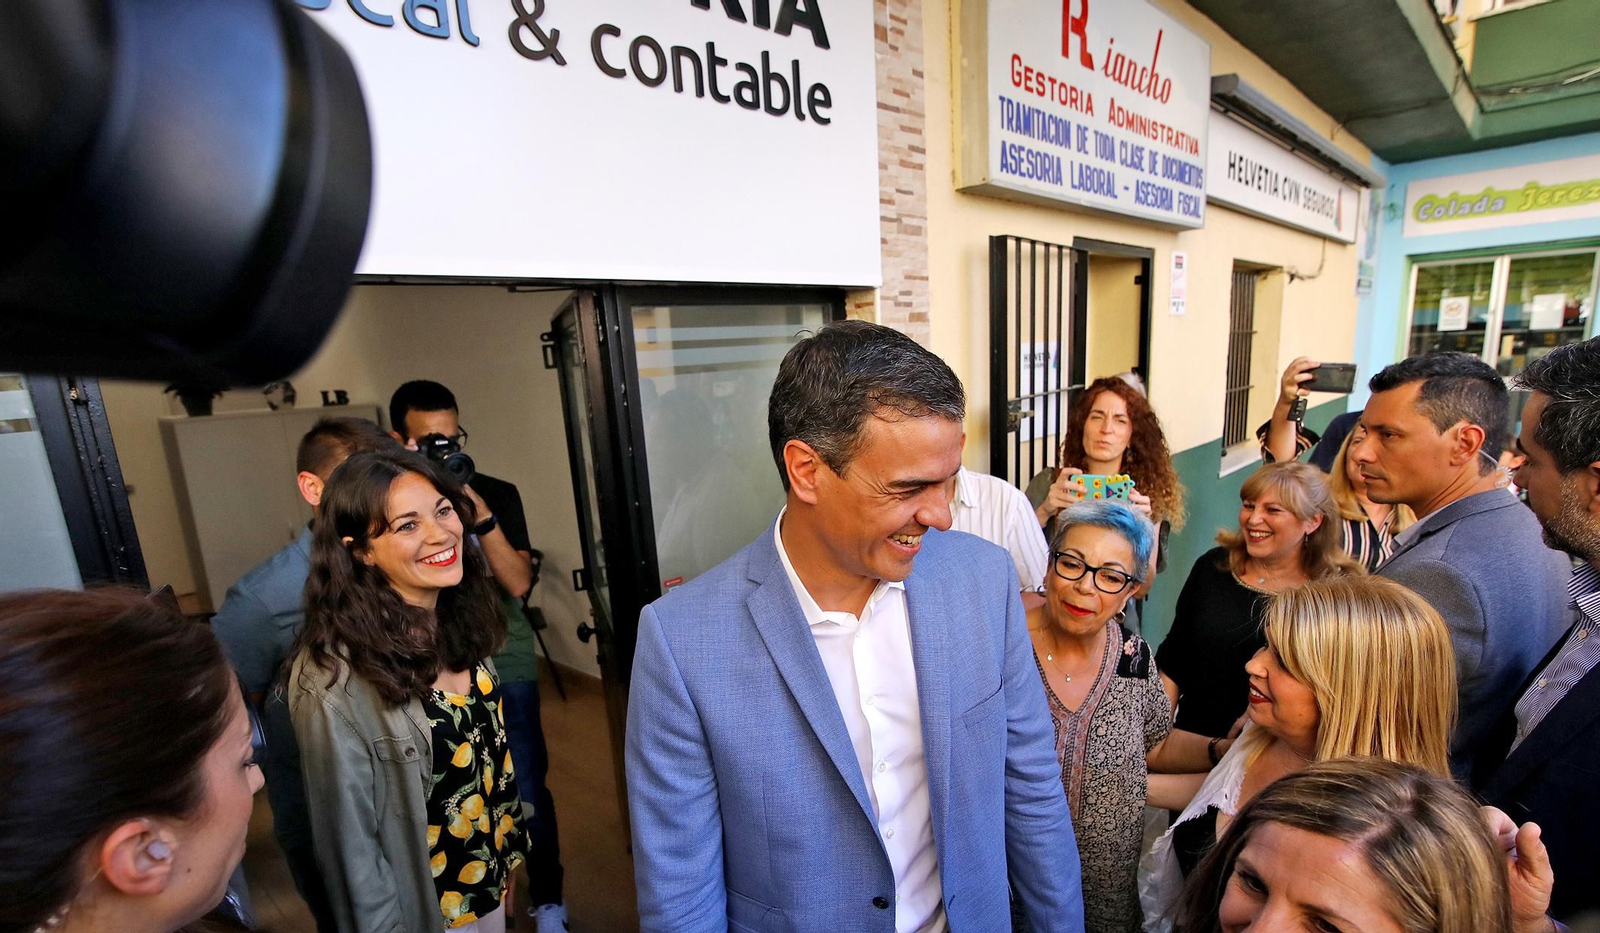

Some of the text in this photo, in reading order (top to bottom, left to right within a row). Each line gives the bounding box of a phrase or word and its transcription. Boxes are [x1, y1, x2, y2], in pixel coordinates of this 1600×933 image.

[507, 0, 568, 67] &
[590, 23, 832, 126] contable
[999, 95, 1203, 190] TRAMITACION DE TODA CLASE DE DOCUMENTOS
[1010, 53, 1199, 157] GESTORIA ADMINISTRATIVA
[1000, 140, 1063, 186] ASESORIA
[1070, 160, 1118, 199] LABORAL
[1135, 179, 1174, 212] ASESORIA
[1178, 191, 1202, 218] FISCAL
[1227, 150, 1279, 198] HELVETIA
[1303, 186, 1335, 219] SEGUROS
[1417, 181, 1600, 222] Colada Jerez
[320, 389, 350, 407] LB
